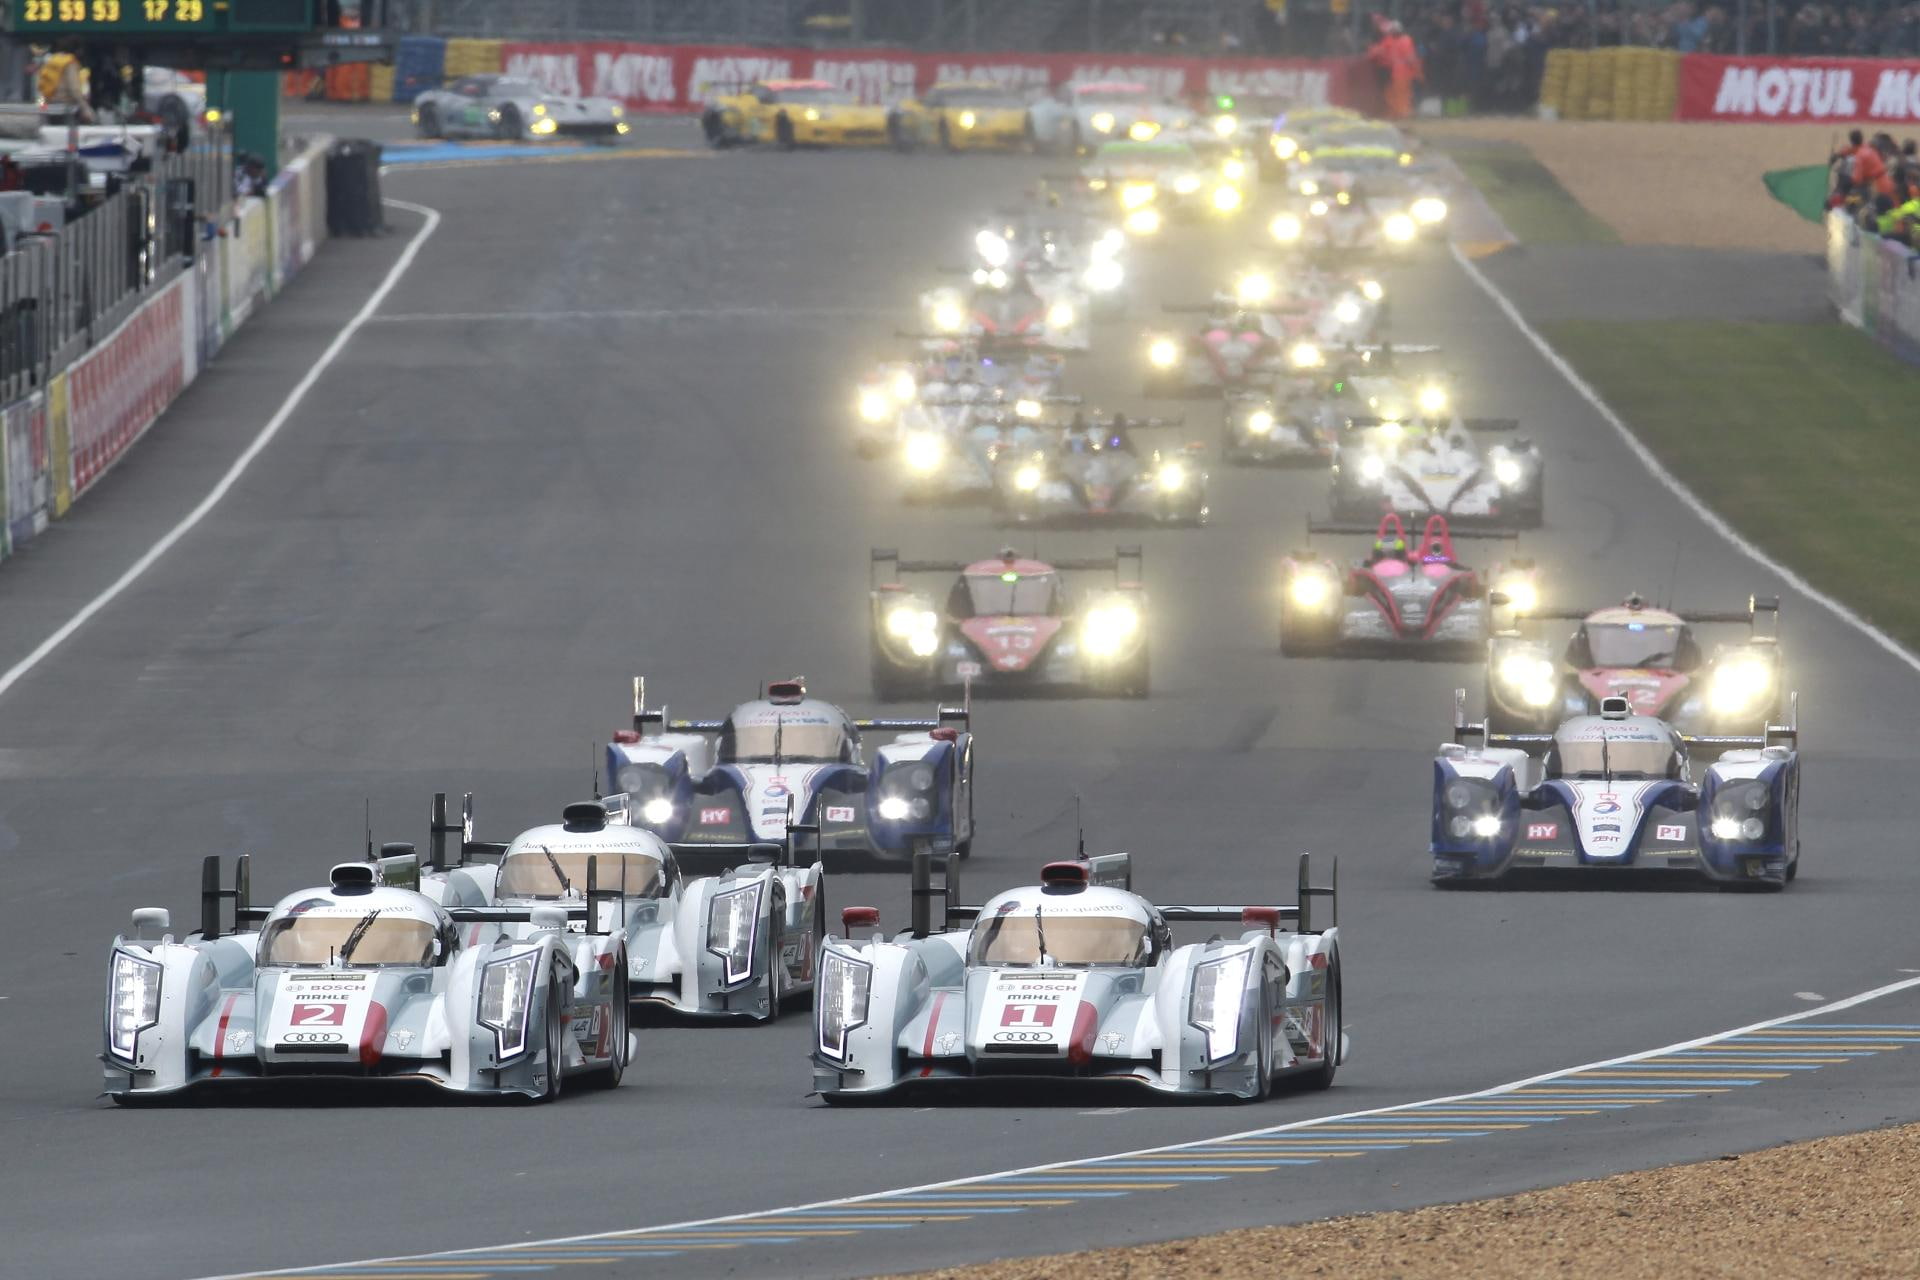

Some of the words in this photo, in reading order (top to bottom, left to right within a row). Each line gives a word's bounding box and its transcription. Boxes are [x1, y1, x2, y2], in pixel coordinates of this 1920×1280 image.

[24, 0, 52, 22] 23
[1714, 66, 1858, 117] MOTUL
[701, 810, 727, 824] HY
[829, 808, 850, 820] P1
[1528, 825, 1556, 838] HY
[1659, 826, 1681, 839] P1
[521, 841, 545, 850] Aud
[599, 841, 641, 851] quattro
[1073, 903, 1124, 914] quattro
[299, 1004, 335, 1025] 2
[1009, 1005, 1044, 1027] 1
